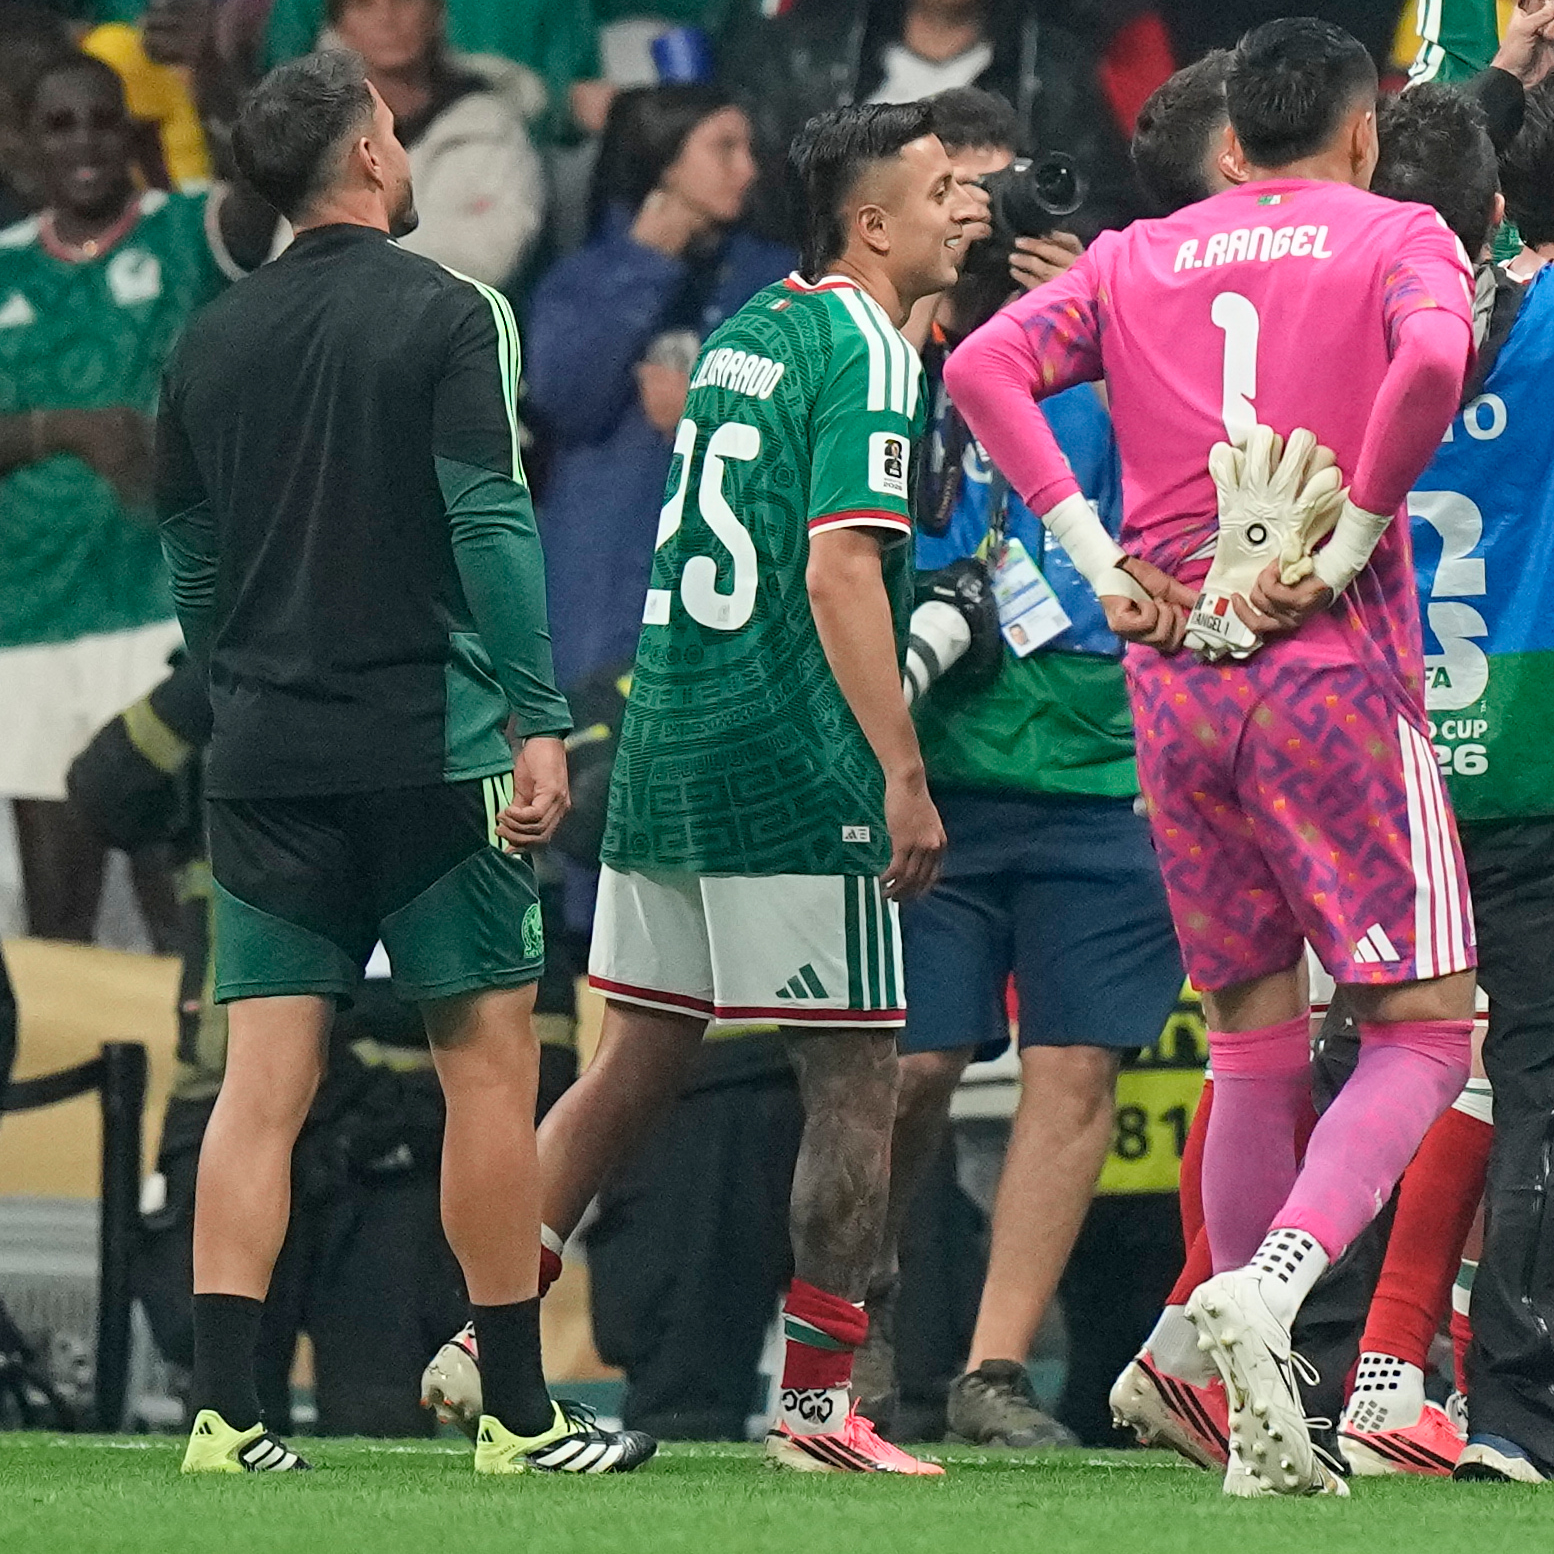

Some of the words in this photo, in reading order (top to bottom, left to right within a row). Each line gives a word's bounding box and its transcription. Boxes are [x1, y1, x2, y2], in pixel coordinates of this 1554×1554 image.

[1174, 225, 1333, 273] R.RANGEL
[1211, 291, 1260, 445] 1
[642, 418, 761, 631] 25
[1443, 719, 1489, 740] CUP
